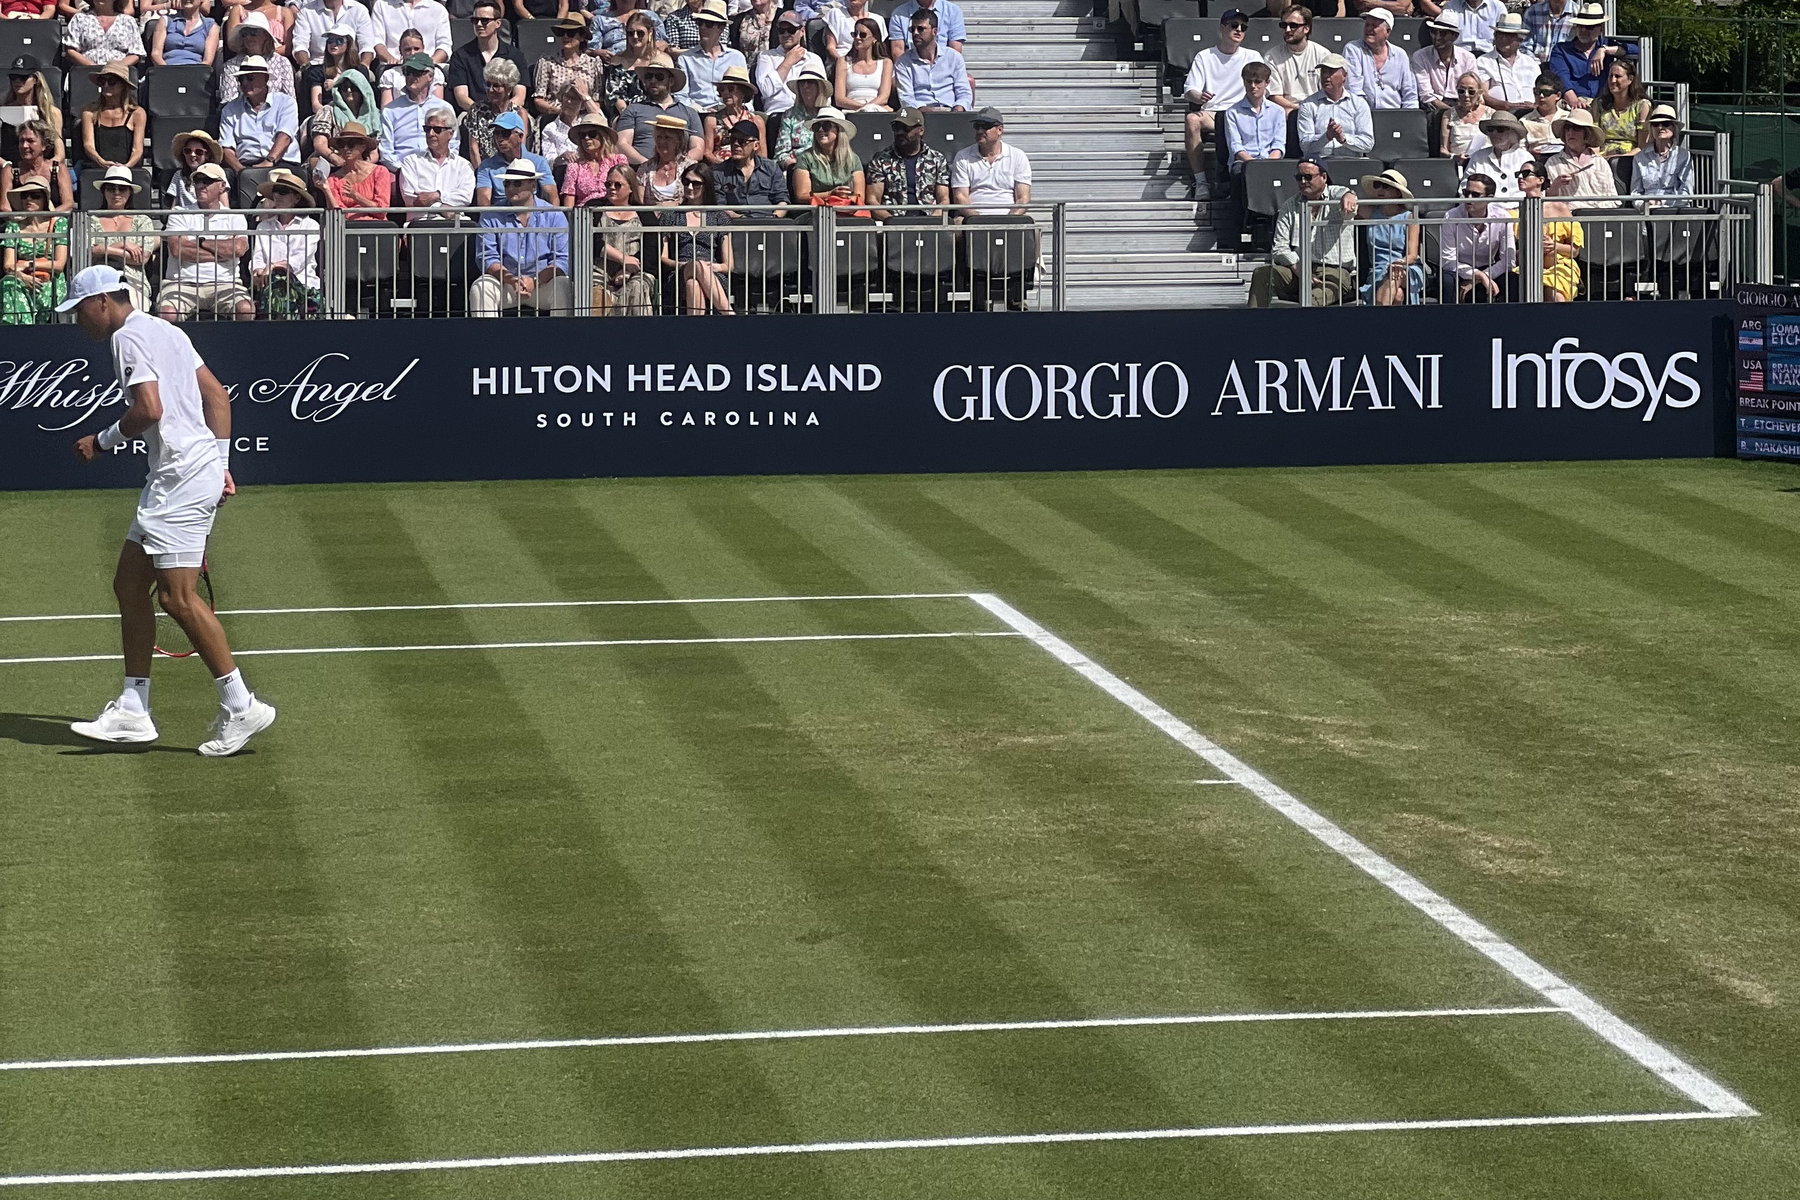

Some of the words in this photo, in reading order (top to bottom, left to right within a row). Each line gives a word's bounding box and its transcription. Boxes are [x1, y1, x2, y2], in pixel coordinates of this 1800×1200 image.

[1737, 290, 1787, 307] GIORGIO
[1741, 320, 1762, 330] ARG
[1742, 360, 1762, 370] USA
[248, 352, 420, 423] Angel
[472, 364, 611, 396] HILTON
[628, 363, 731, 392] HEAD
[745, 363, 882, 392] ISLAND
[932, 361, 1189, 422] GIORGIO
[1210, 354, 1444, 416] ARMANI
[1492, 337, 1701, 422] Infosys
[1739, 397, 1769, 409] BREAK
[536, 411, 637, 428] SOUTH
[659, 410, 820, 426] CAROLINA
